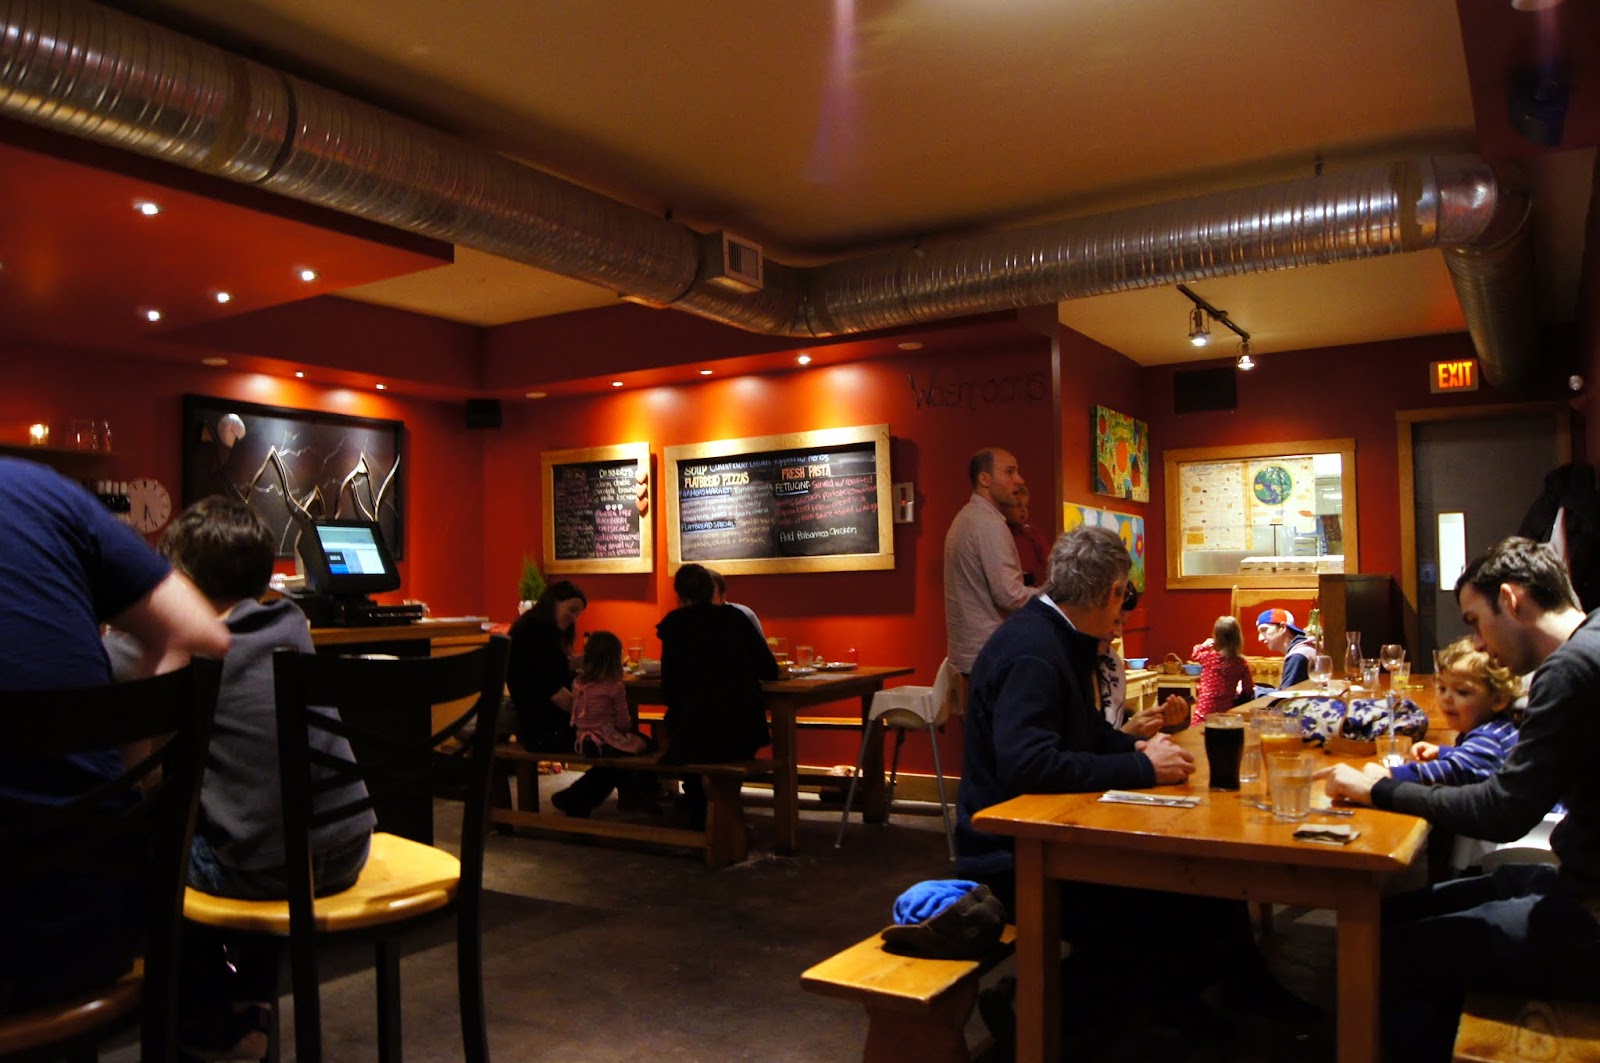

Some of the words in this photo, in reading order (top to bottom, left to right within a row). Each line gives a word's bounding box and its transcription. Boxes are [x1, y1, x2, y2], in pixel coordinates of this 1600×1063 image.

[1438, 361, 1472, 388] EXIT
[684, 465, 707, 476] SOUP
[781, 466, 805, 480] FRESH
[808, 463, 832, 478] PASTA
[684, 473, 720, 488] FLATBREAD
[722, 471, 750, 486] PIZZAS
